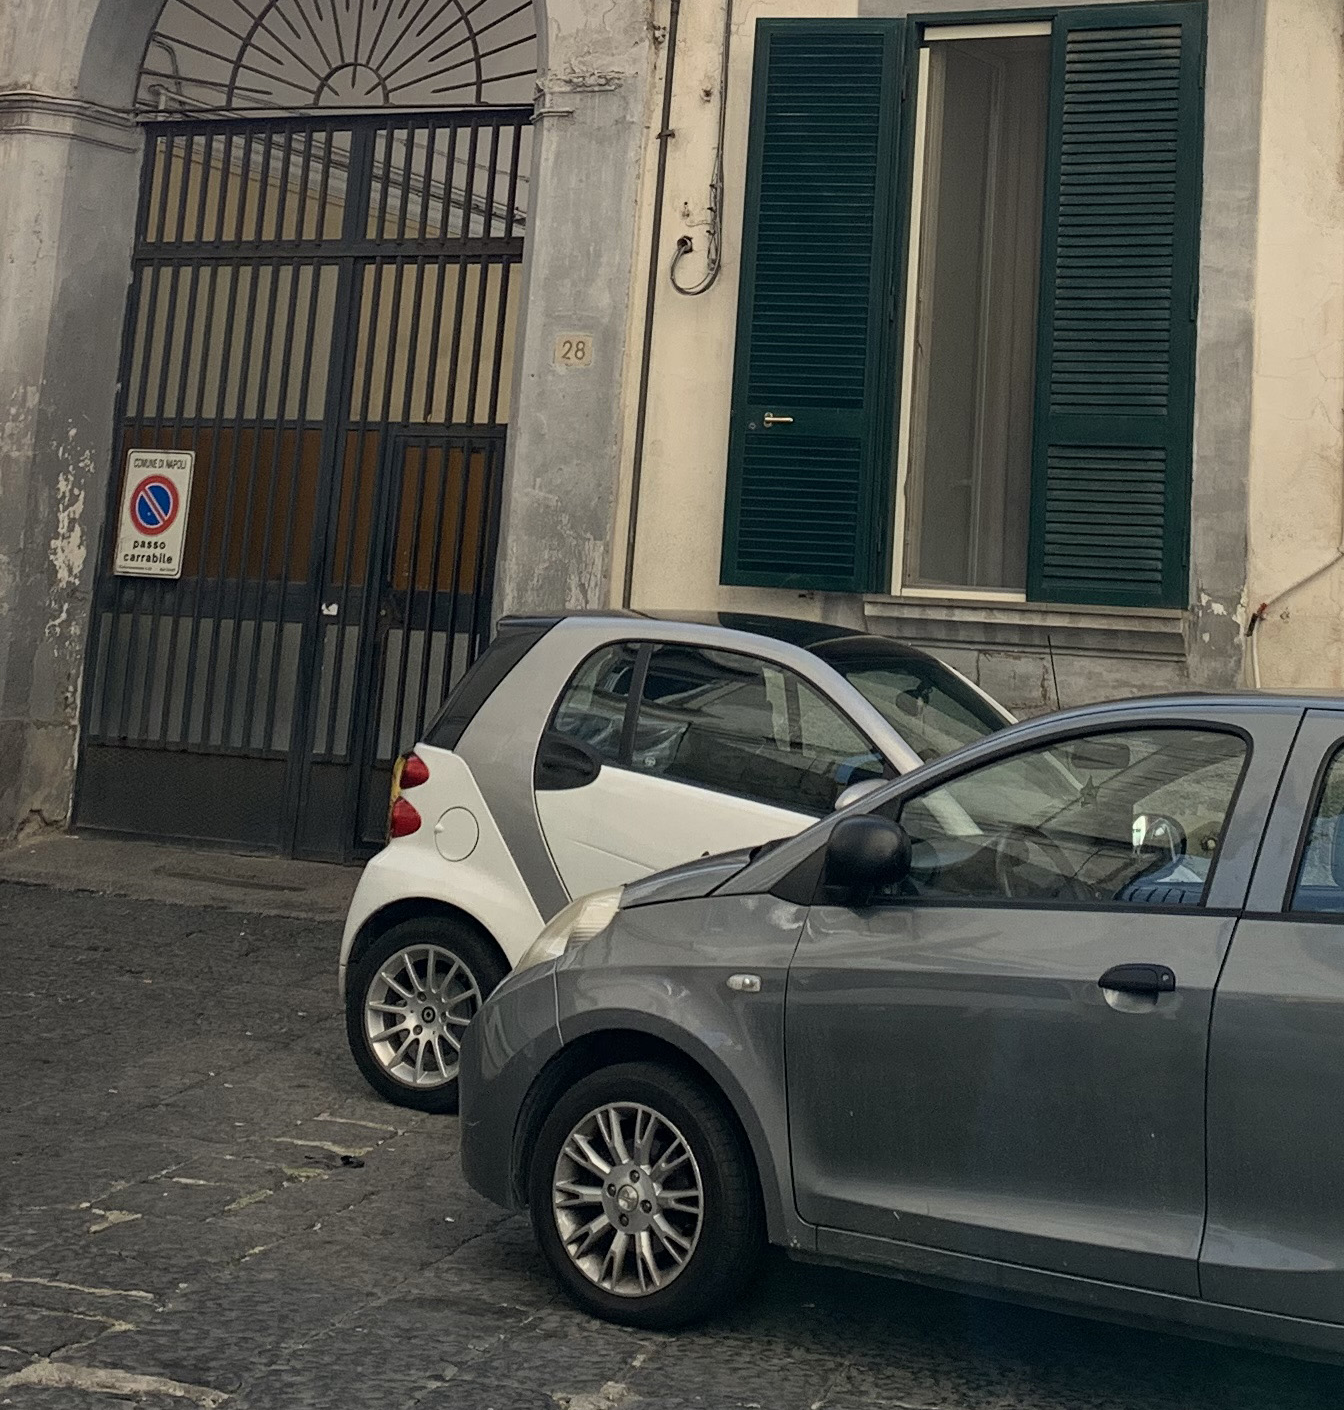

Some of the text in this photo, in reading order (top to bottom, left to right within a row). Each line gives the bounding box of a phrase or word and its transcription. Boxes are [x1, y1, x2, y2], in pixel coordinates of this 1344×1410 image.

[561, 340, 586, 361] 28
[132, 540, 166, 550] passo
[123, 552, 173, 564] carrabile
